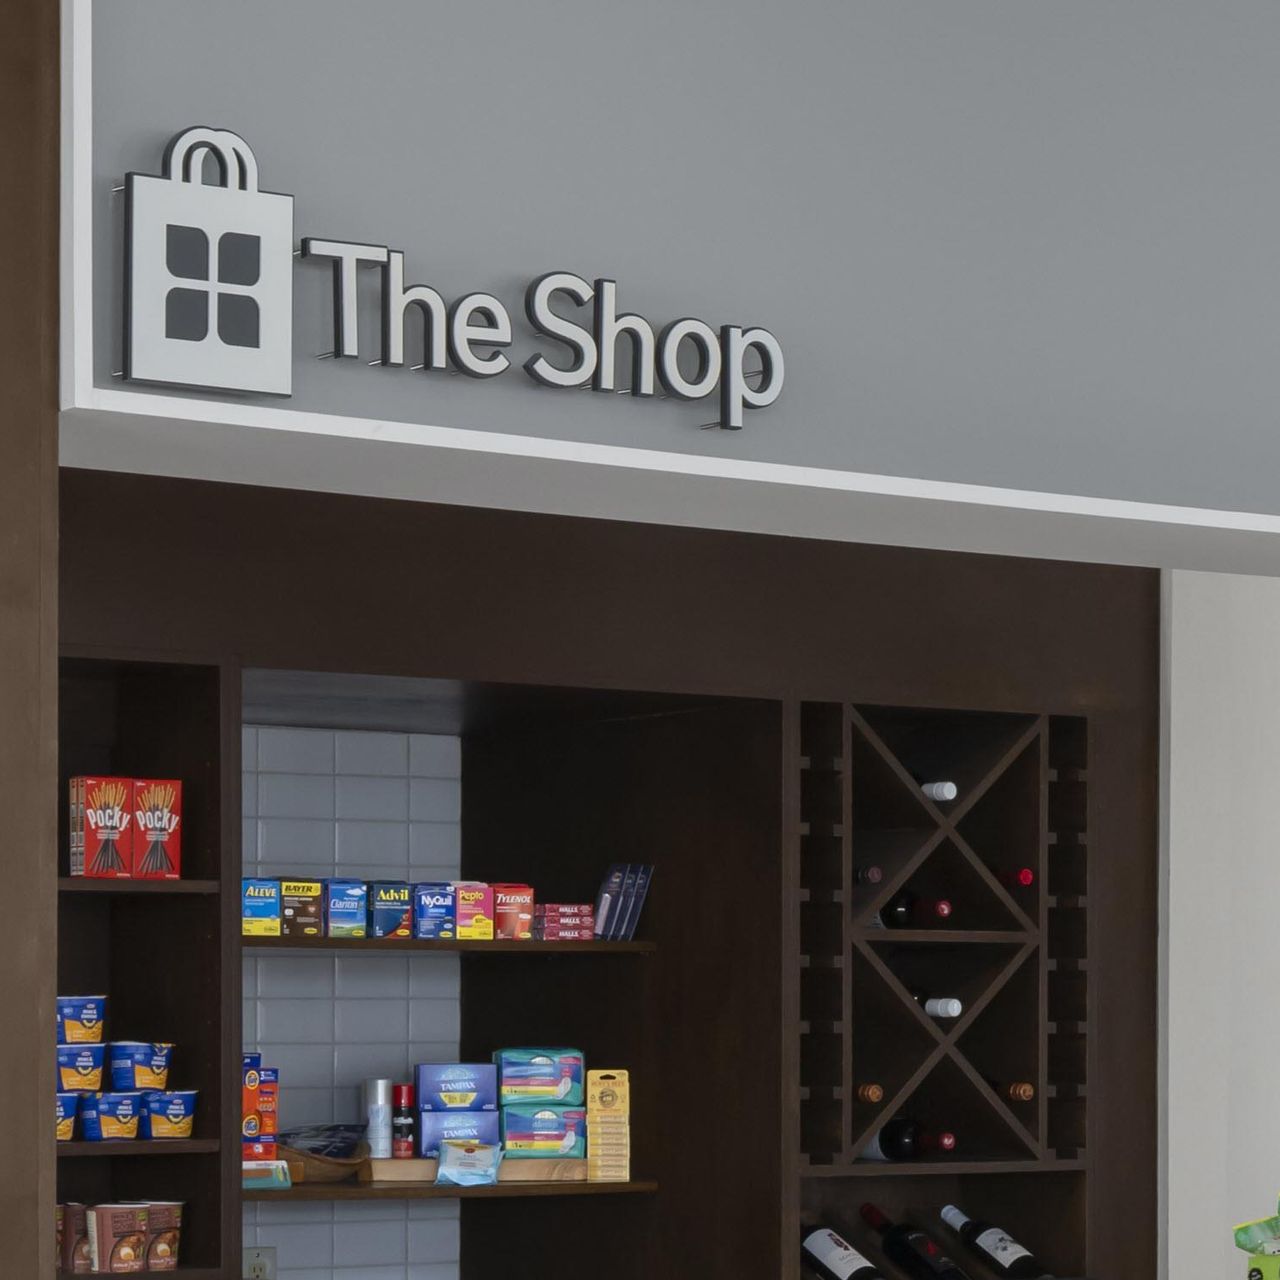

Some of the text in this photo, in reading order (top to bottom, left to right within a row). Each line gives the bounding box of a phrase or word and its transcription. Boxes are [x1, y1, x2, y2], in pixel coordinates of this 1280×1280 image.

[301, 237, 785, 430] The Shop
[377, 889, 409, 901] Advil
[421, 895, 453, 908] NyQuil
[440, 1081, 476, 1091] TAMPAX
[443, 1127, 479, 1138] TAMPAX
